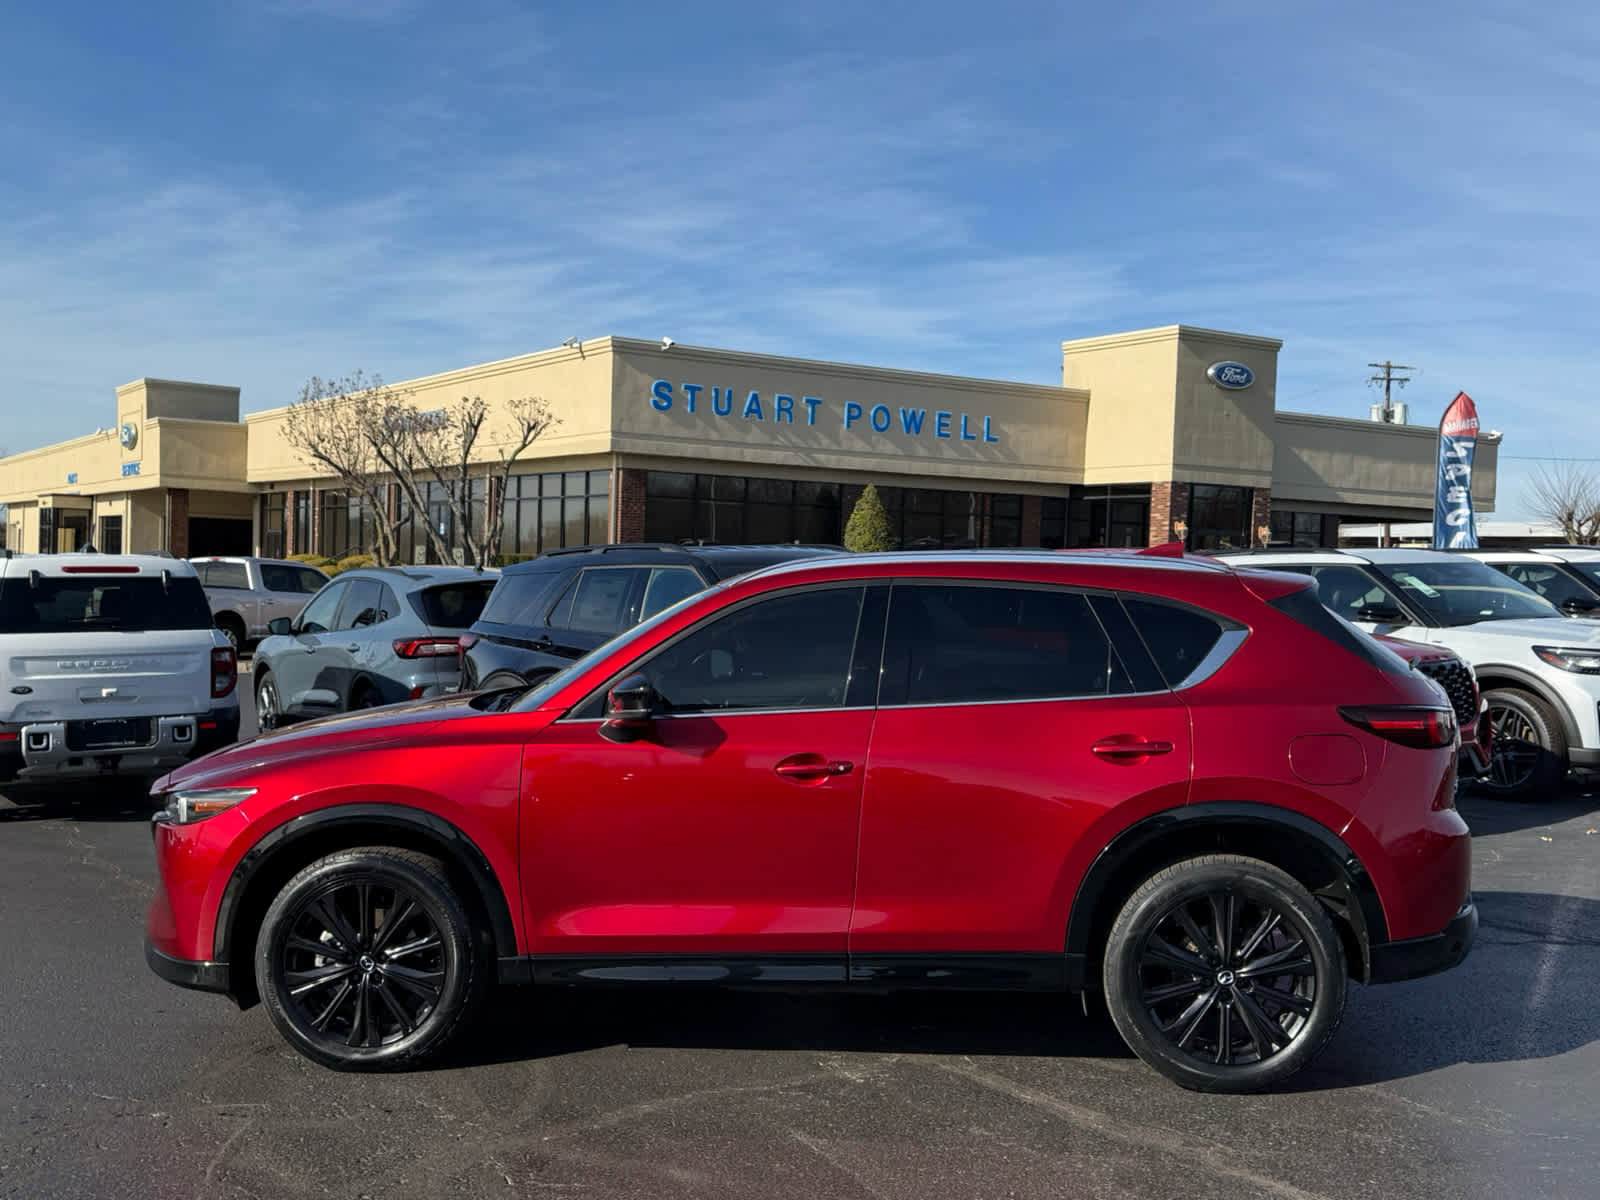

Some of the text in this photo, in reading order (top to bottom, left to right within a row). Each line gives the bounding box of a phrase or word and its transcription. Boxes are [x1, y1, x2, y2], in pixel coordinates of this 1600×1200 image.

[1221, 366, 1248, 384] Ford
[650, 379, 1000, 443] STUART POWELL
